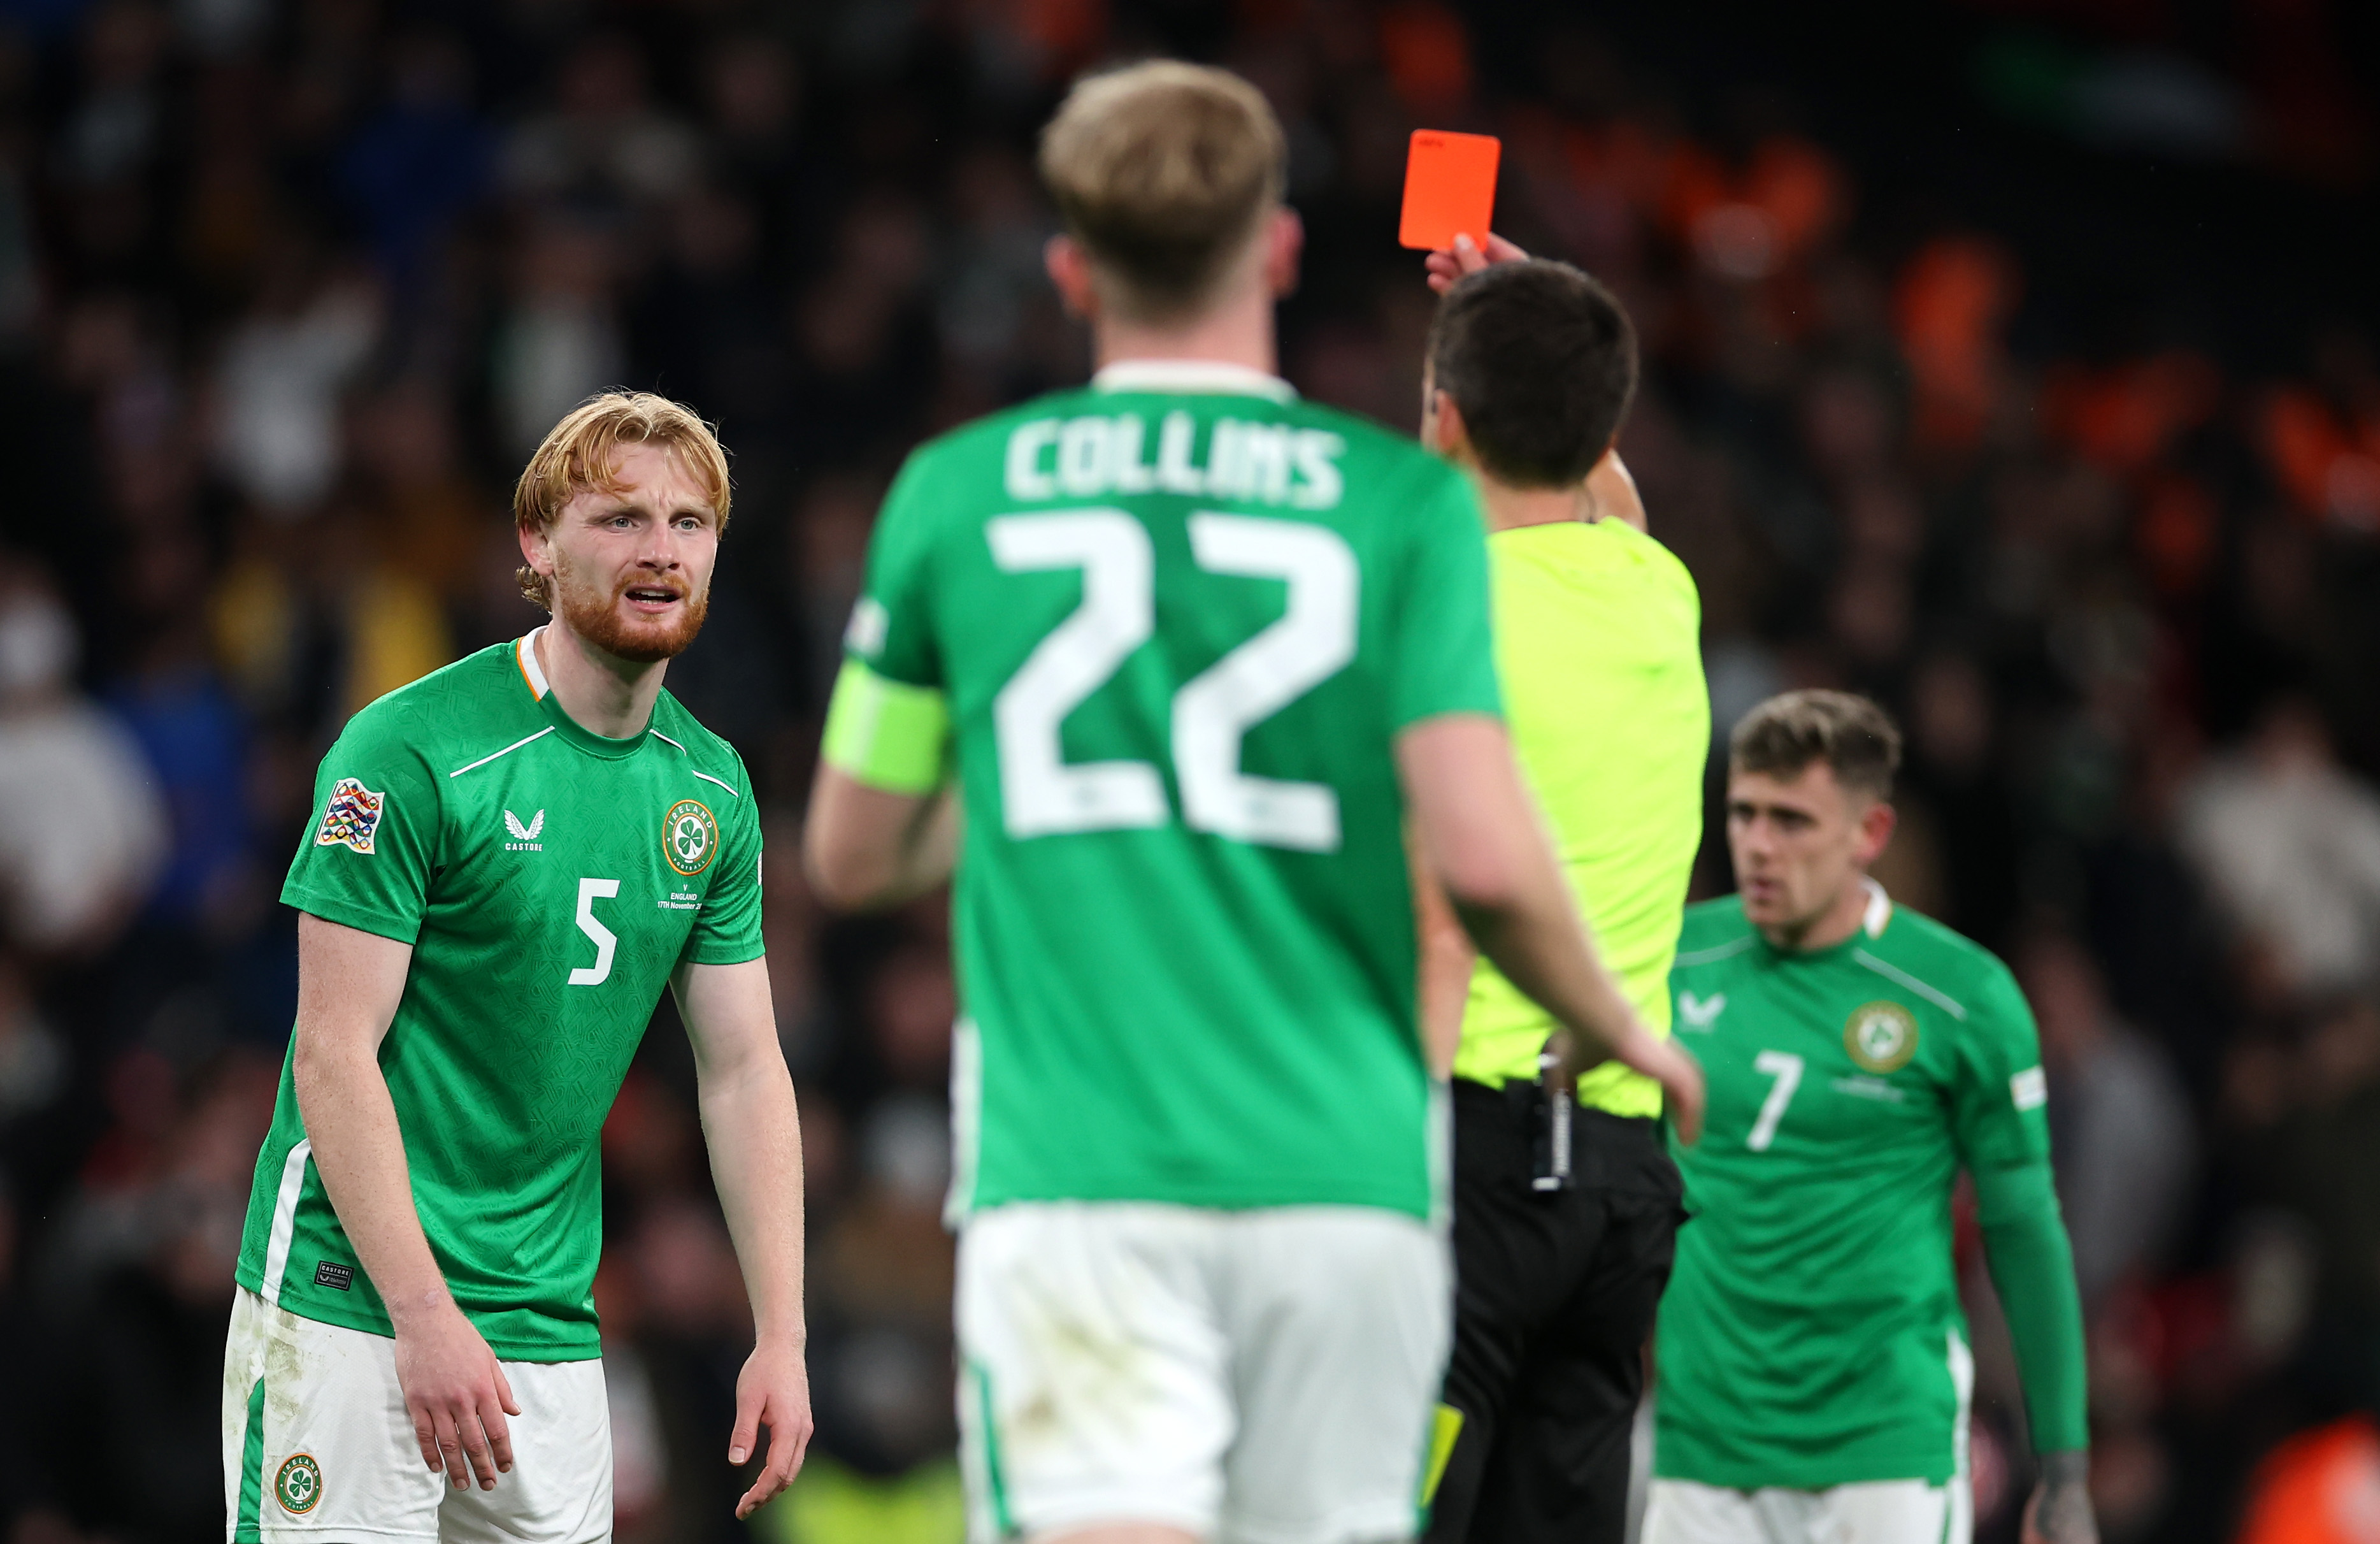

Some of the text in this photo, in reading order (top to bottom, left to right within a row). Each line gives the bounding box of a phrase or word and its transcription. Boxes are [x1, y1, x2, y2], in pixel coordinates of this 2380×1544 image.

[1005, 411, 1345, 509] COLLINS
[986, 508, 1359, 852] 22
[668, 804, 712, 828] IRELAND
[505, 843, 542, 851] CASTORE
[673, 858, 705, 870] FOOTBALL
[670, 892, 697, 900] ENGLAND
[568, 877, 620, 985] 5
[1745, 1050, 1804, 1151] 7
[322, 1266, 349, 1276] CASTORE
[282, 1458, 319, 1476] IRELAND
